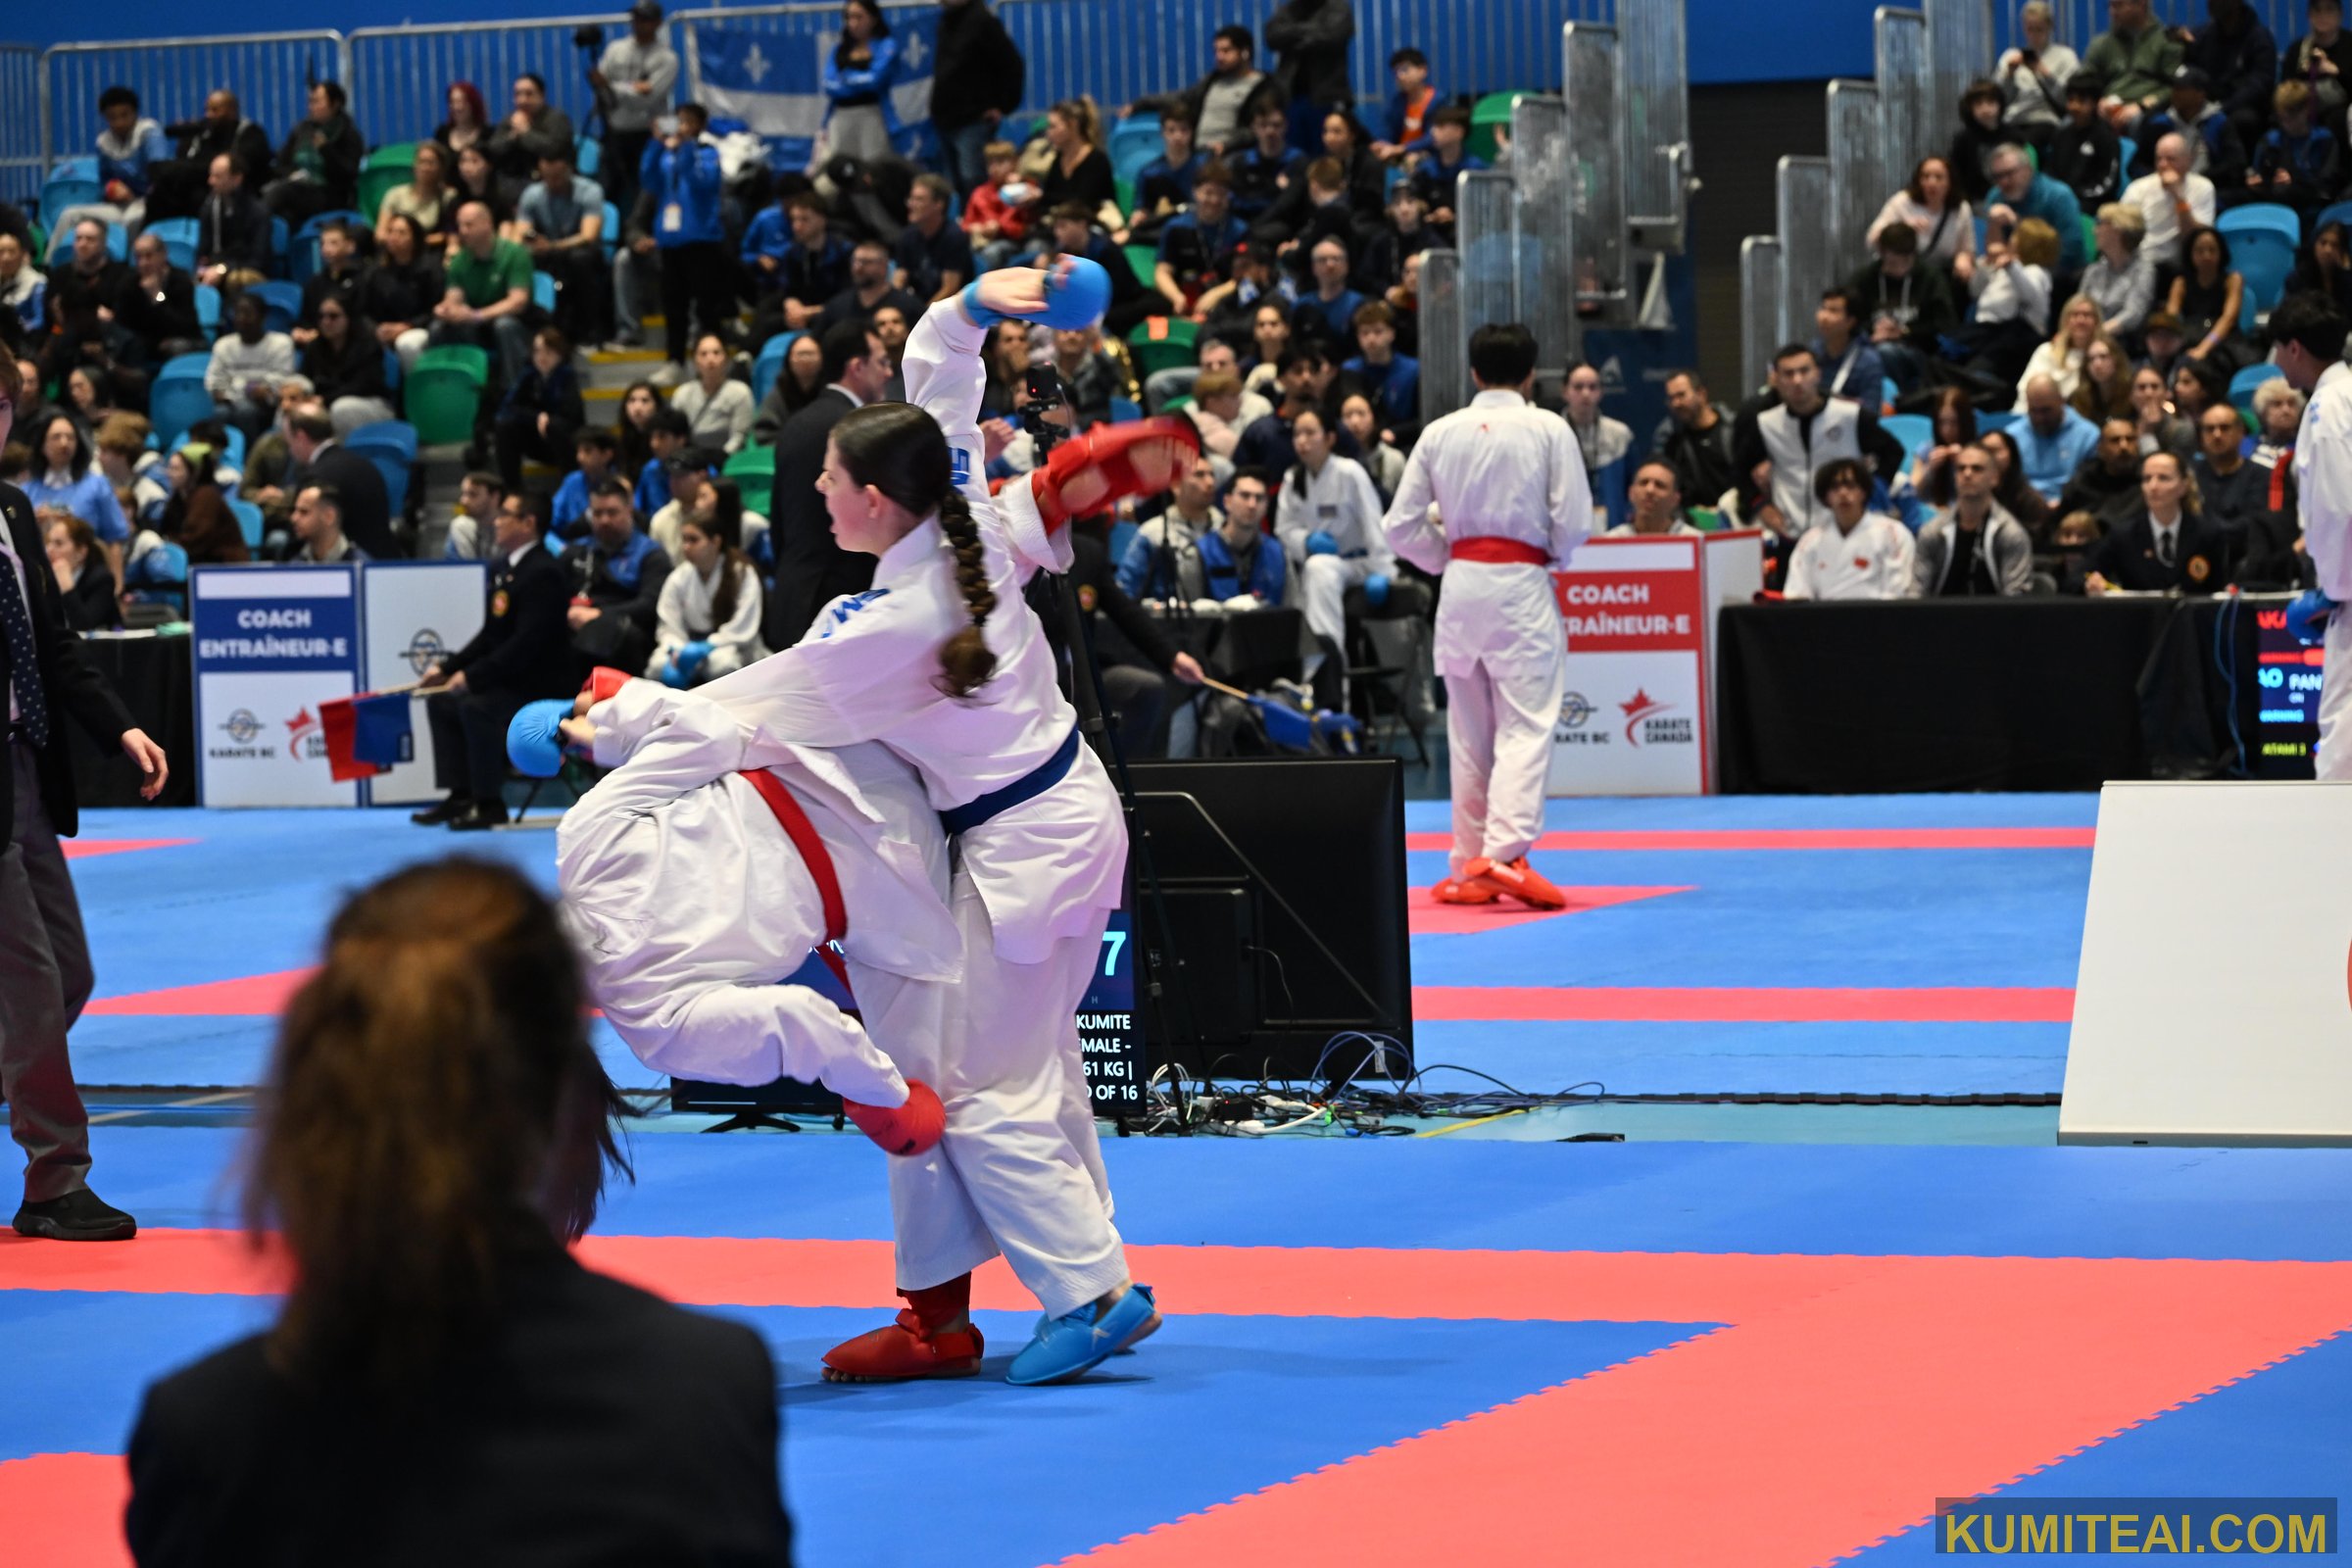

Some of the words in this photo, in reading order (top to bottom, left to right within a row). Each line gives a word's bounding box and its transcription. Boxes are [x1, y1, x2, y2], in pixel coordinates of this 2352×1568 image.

[1567, 585, 1649, 605] COACH
[237, 610, 312, 629] COACH
[1645, 719, 1691, 730] KARATE
[1645, 733, 1693, 744] CANADA
[1102, 931, 1127, 976] 7
[1076, 1014, 1132, 1030] KUMITE
[1078, 1038, 1121, 1054] MALE
[1082, 1061, 1099, 1076] 61
[1103, 1061, 1125, 1077] KG
[1096, 1084, 1116, 1100] OF
[1120, 1085, 1138, 1101] 16
